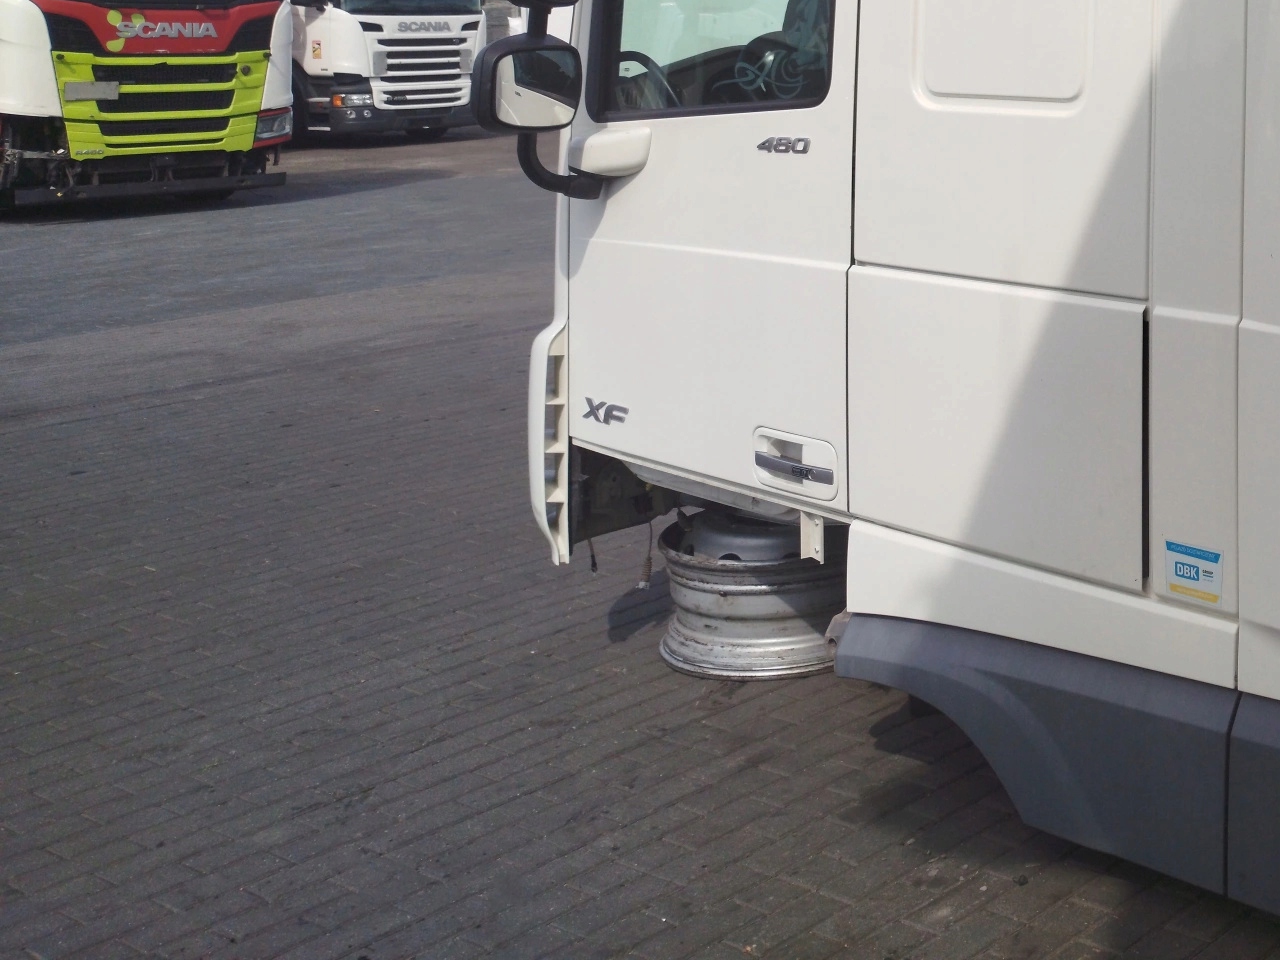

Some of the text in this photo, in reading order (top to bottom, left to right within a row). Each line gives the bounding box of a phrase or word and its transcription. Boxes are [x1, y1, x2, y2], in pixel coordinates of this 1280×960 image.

[116, 22, 218, 38] SCANIA
[398, 21, 451, 32] SCANIA
[757, 137, 811, 154] 480
[582, 397, 629, 425] XF
[1176, 563, 1198, 579] DBK
